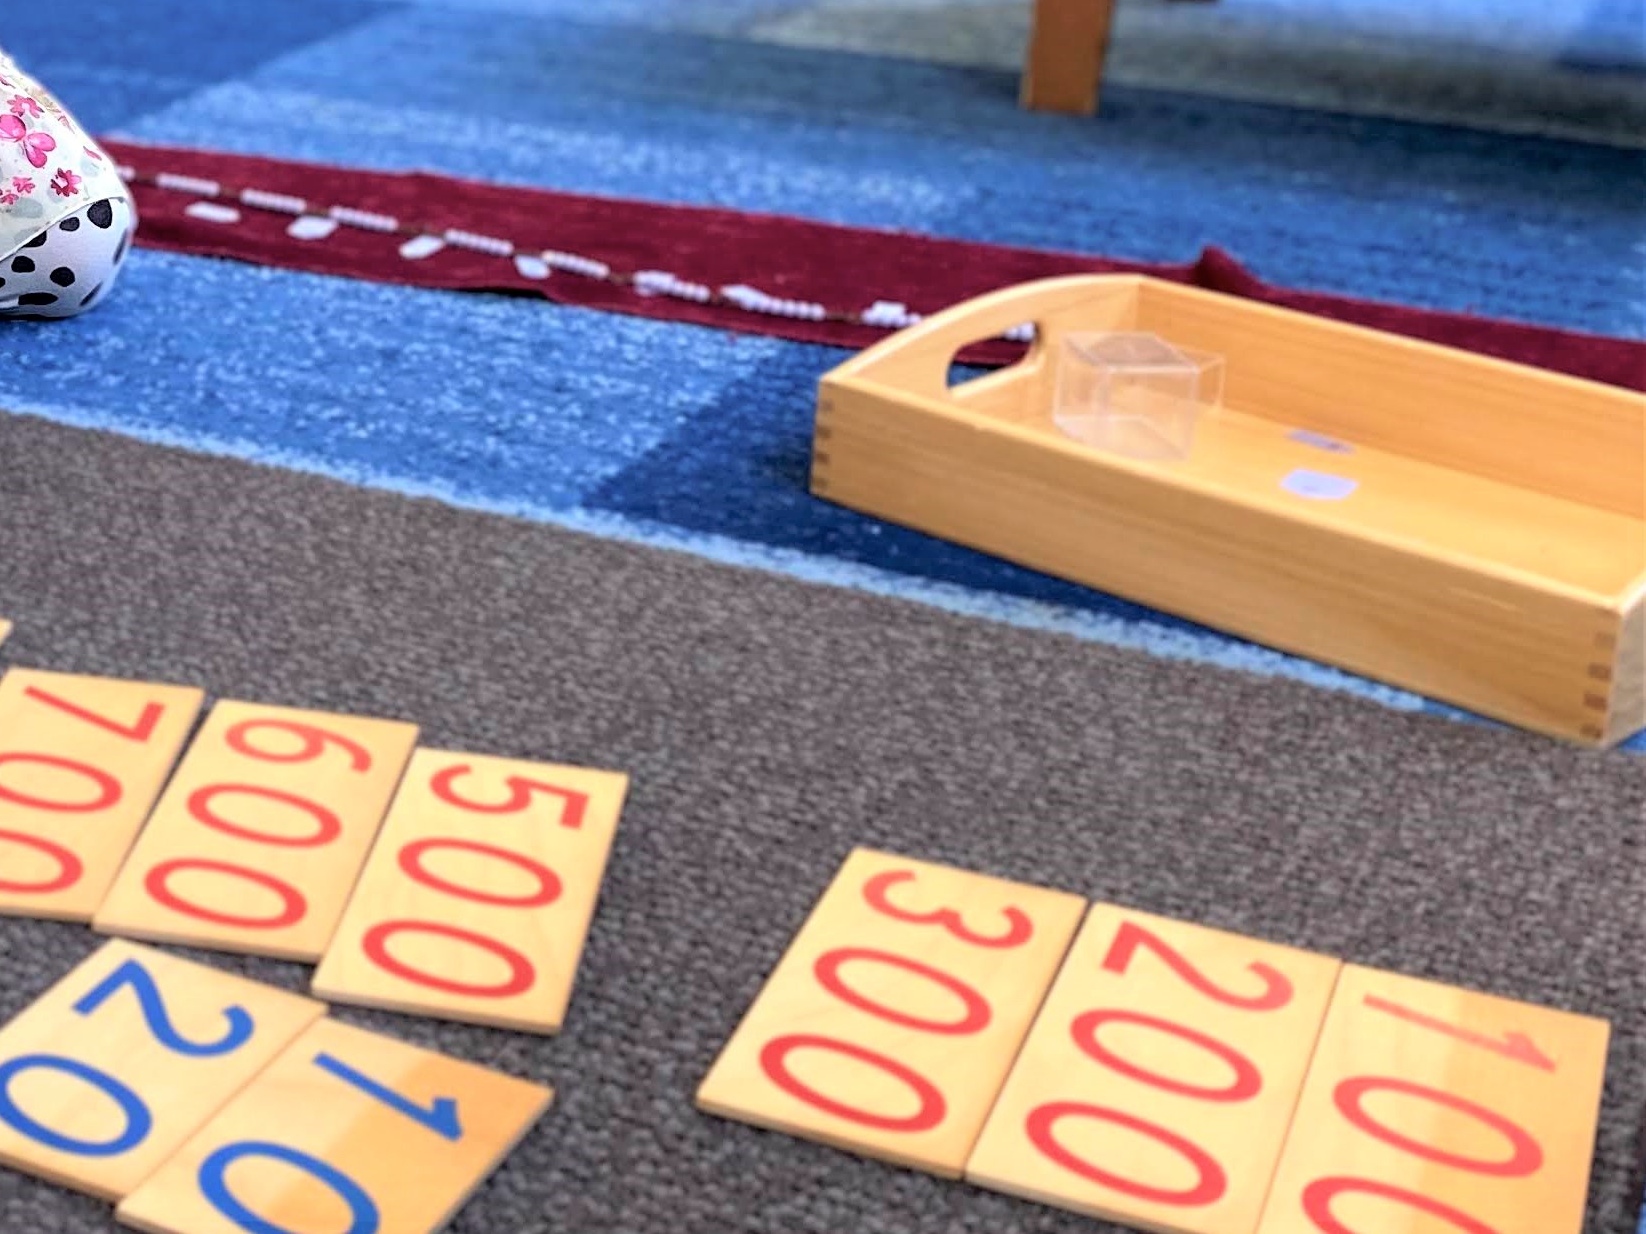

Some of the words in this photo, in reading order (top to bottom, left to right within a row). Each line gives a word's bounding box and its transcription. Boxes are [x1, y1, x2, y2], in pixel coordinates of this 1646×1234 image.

[143, 718, 373, 932] 600
[360, 763, 590, 1001] 500
[757, 869, 1035, 1135] 300
[1024, 920, 1295, 1209] 200
[197, 1052, 464, 1234] 10
